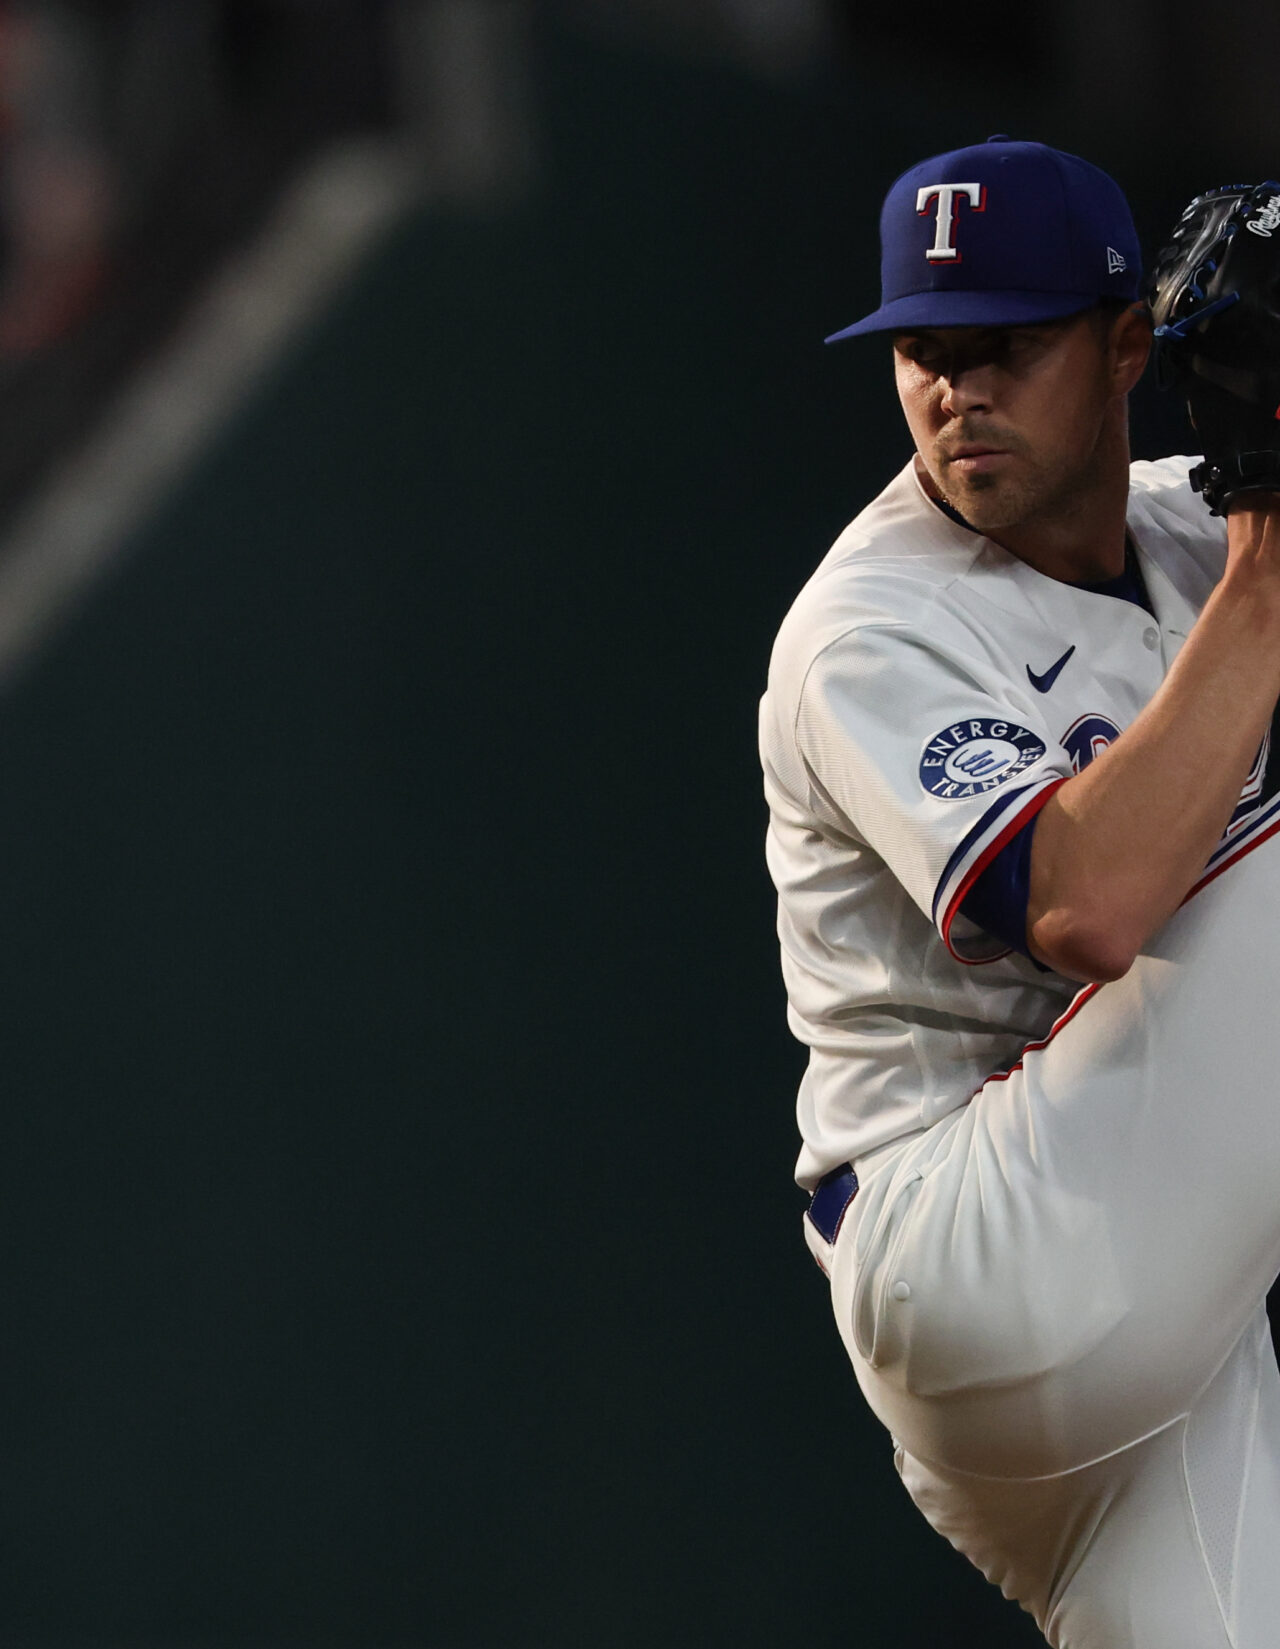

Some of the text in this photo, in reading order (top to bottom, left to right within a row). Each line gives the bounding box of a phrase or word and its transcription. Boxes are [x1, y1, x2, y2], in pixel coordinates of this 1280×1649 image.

[916, 183, 987, 264] T
[923, 721, 1030, 767] ENERGY
[931, 746, 1042, 797] TRANSFER
